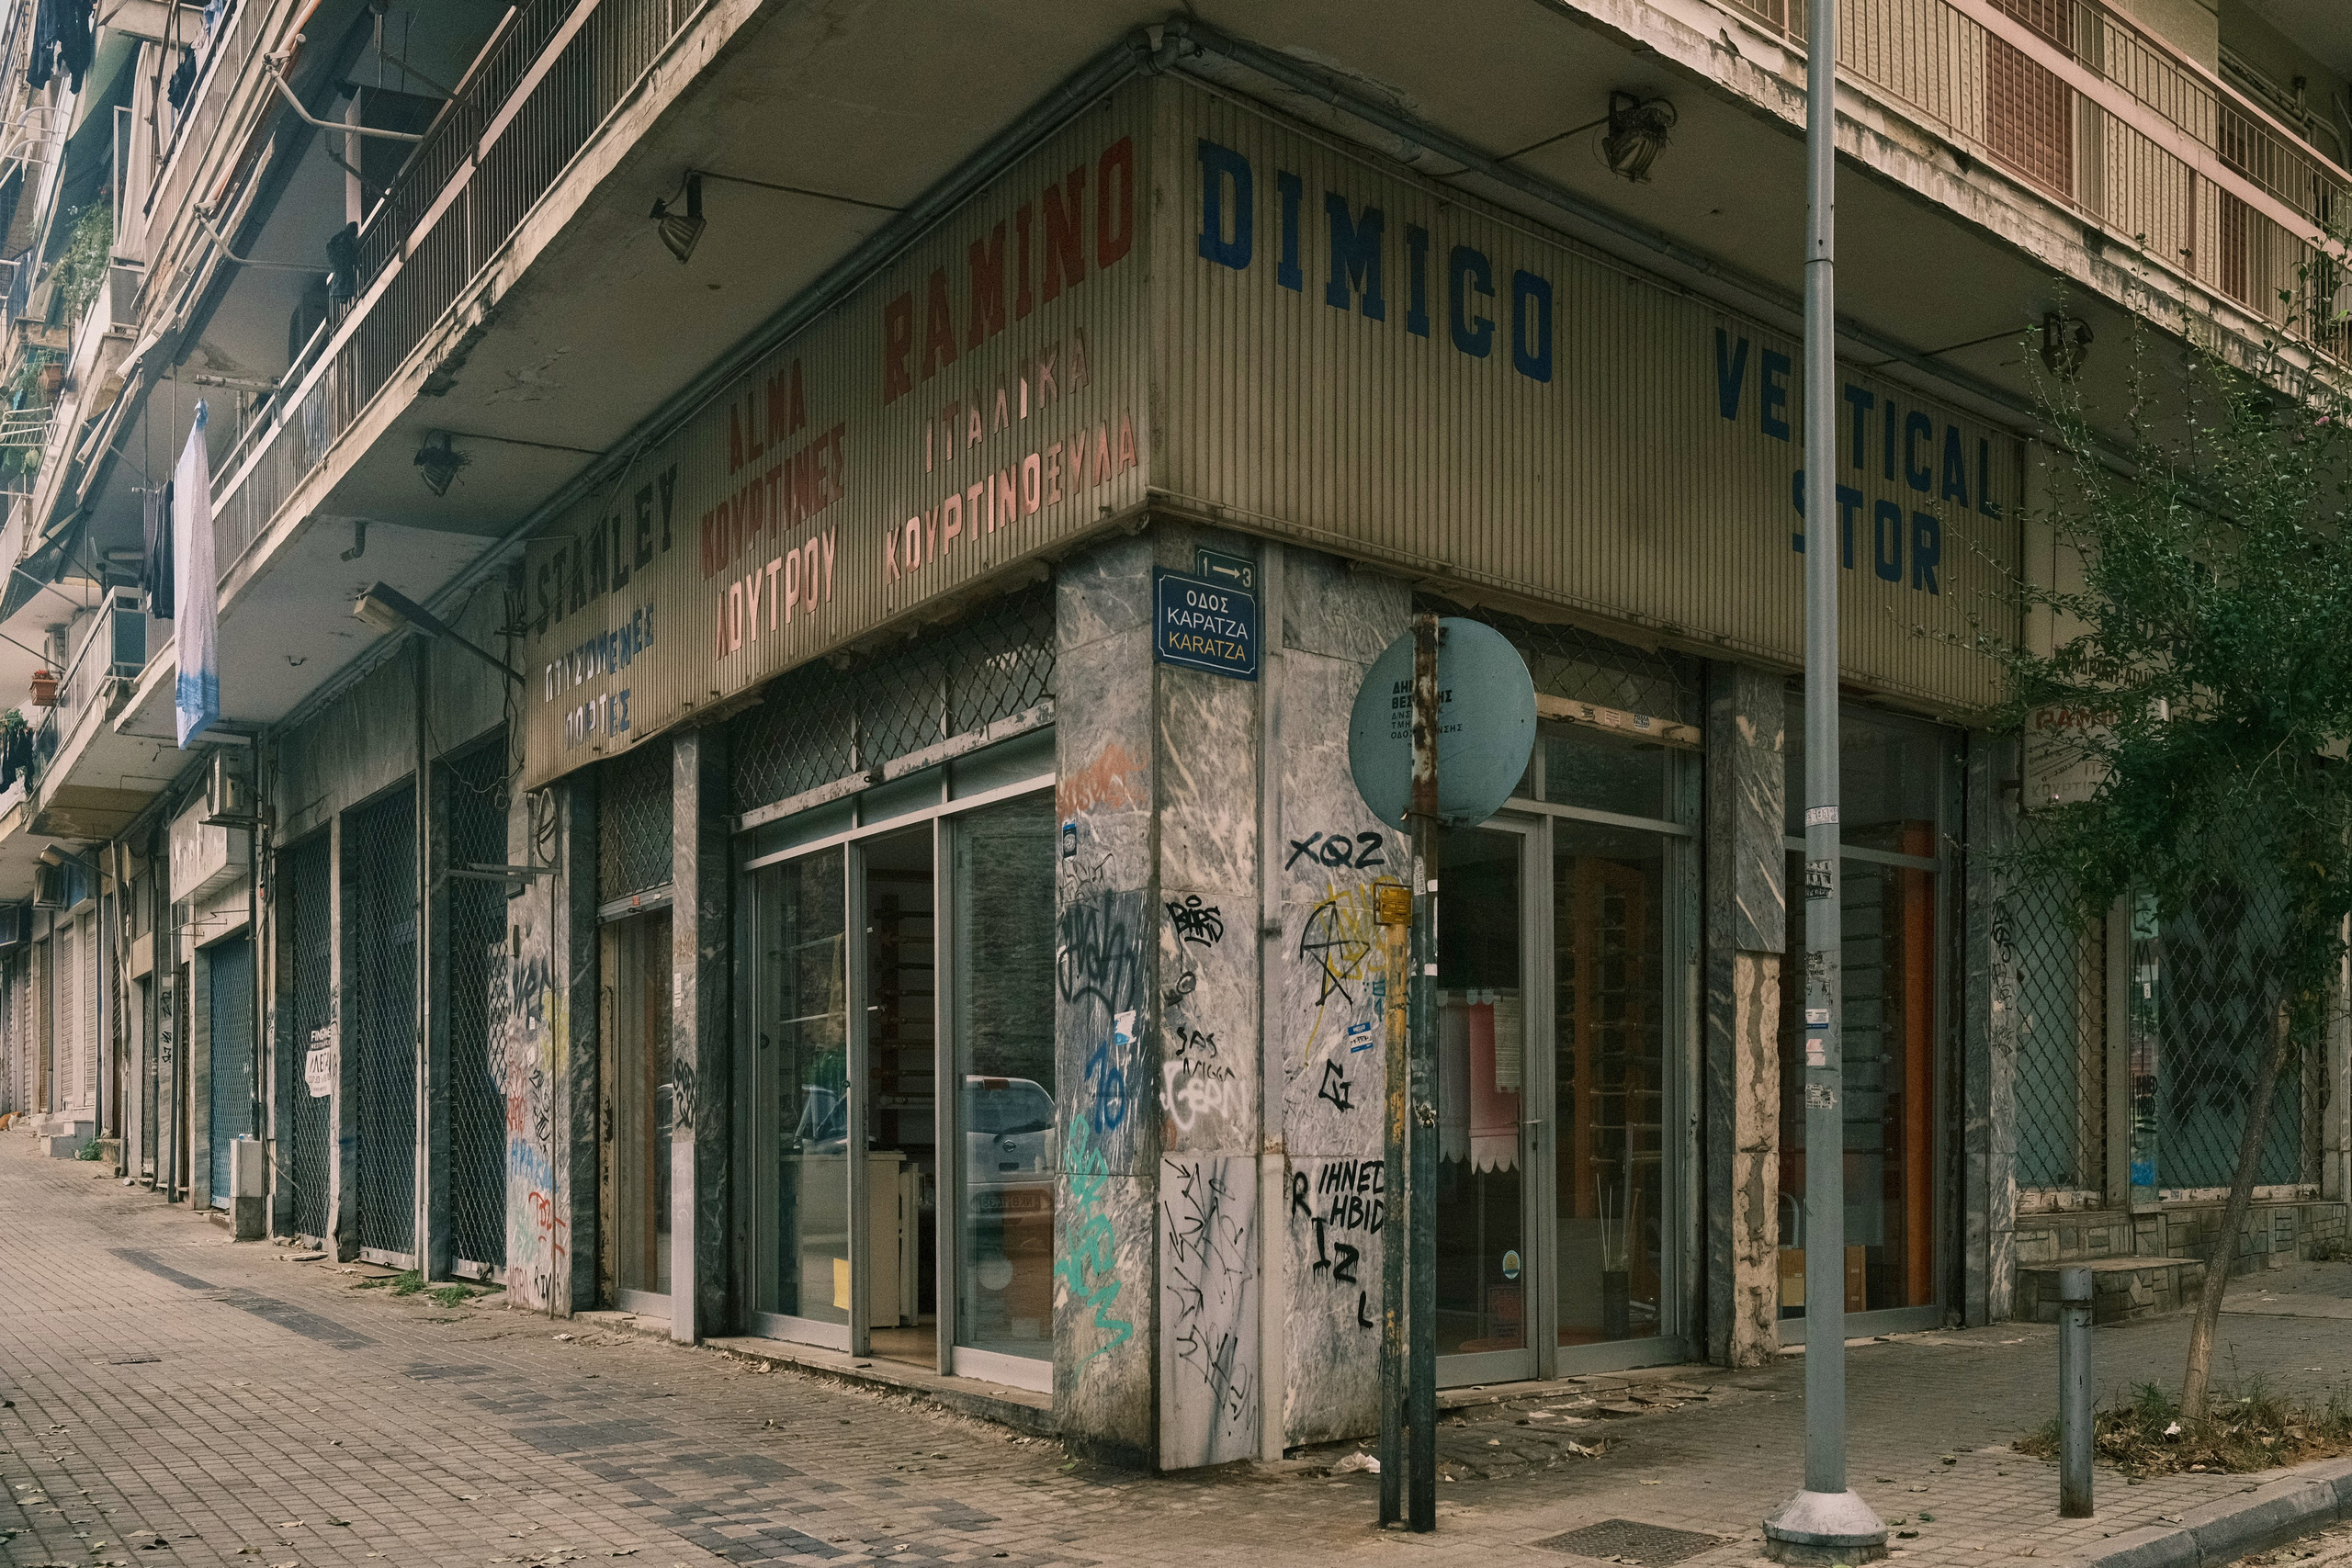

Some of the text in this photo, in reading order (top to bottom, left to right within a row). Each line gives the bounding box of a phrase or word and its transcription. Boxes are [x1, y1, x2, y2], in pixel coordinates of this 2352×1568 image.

[884, 135, 1133, 407] RAMINO
[924, 327, 1090, 474] ΙΤΑΛΙΚΑ
[1715, 327, 2001, 521] VETICAL
[536, 463, 678, 637] STANLEY
[701, 422, 845, 581] ΚΟΥΡΤΙΝΕΣ
[886, 407, 1138, 585] ΚΟΥΡΤΙΝΟΞΥΛΑ
[716, 525, 838, 661] ΛΟΥΤΡΟΥ
[1168, 606, 1249, 640] ΚΑΡΑΤΖΑ
[1186, 590, 1229, 614] ΟΔΟΣ
[1204, 557, 1251, 587] 1 3
[1169, 631, 1247, 661] KARATZA
